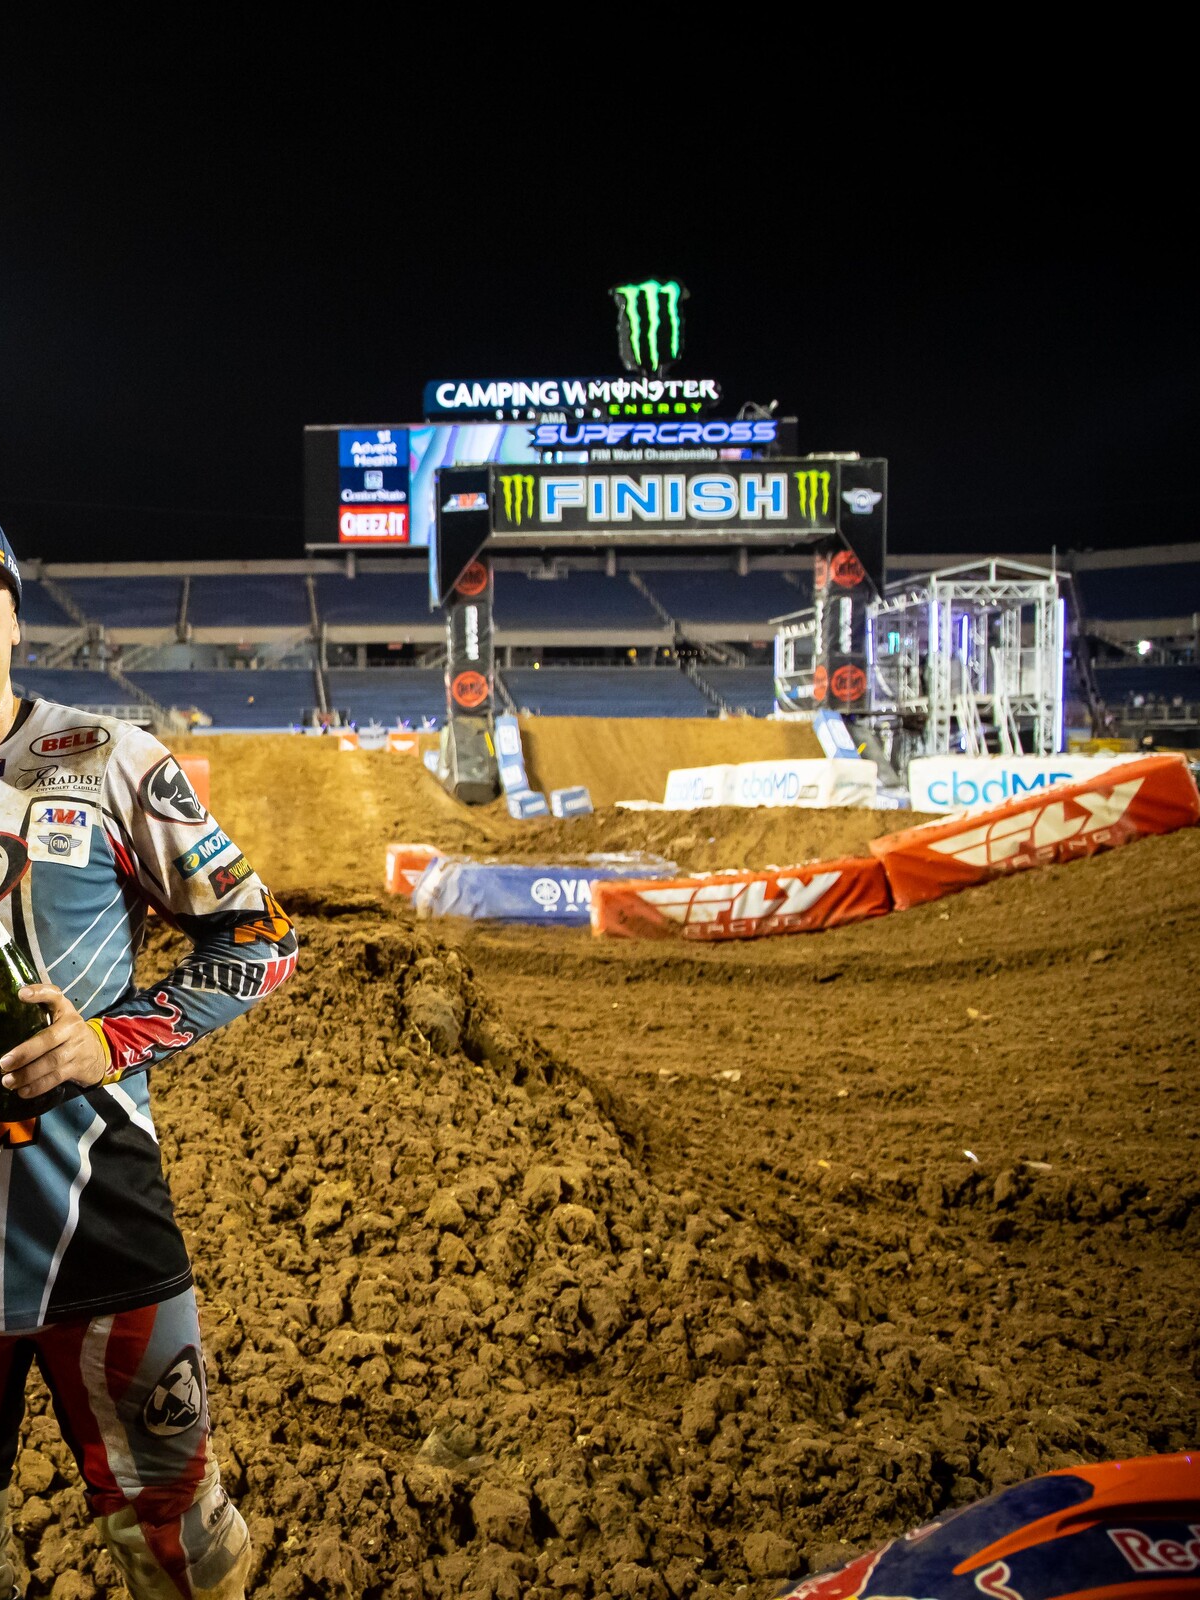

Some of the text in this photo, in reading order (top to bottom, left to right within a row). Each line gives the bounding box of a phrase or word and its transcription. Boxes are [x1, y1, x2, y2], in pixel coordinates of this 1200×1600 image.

[436, 380, 559, 407] CAMPING
[588, 377, 718, 403] MONSTER
[541, 412, 567, 424] AMA
[609, 403, 703, 415] ENERGY
[535, 421, 777, 445] SUPERCROSS
[591, 447, 718, 461] FIM World Championship
[540, 473, 788, 522] FINISH
[41, 731, 101, 752] BELL
[36, 807, 87, 828] AMA
[52, 838, 68, 849] FIM
